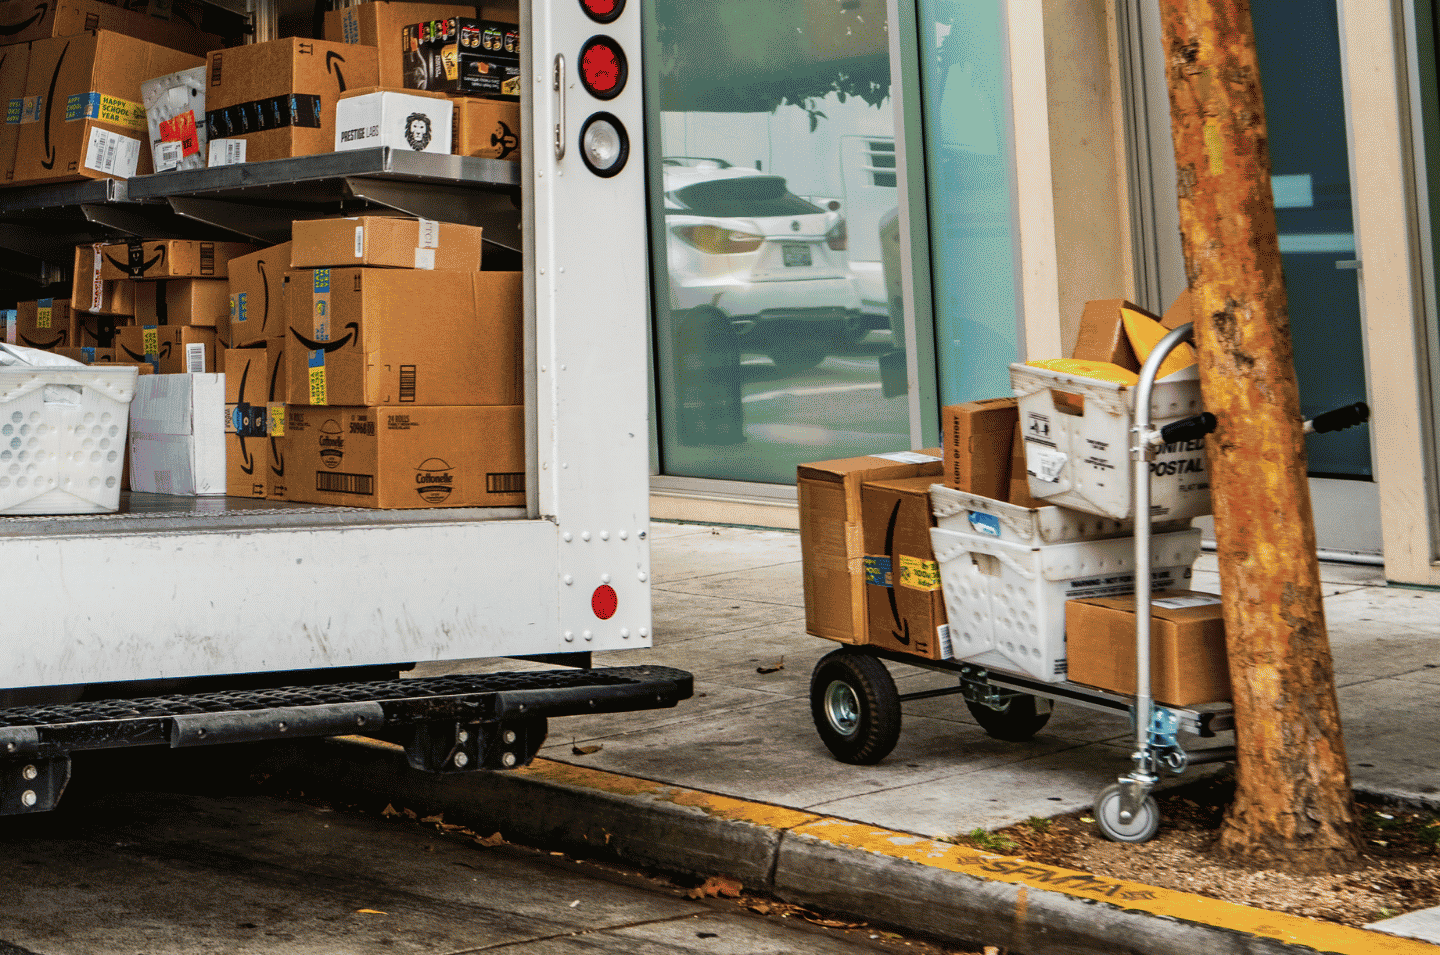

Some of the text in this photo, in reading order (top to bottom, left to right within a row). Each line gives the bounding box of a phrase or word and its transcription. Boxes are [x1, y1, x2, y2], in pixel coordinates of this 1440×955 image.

[103, 97, 127, 109] HAPPY
[102, 104, 130, 117] SCHOOL
[102, 112, 120, 122] YEAR
[340, 127, 366, 143] PRESTIGE
[416, 473, 453, 484] Cottonelle
